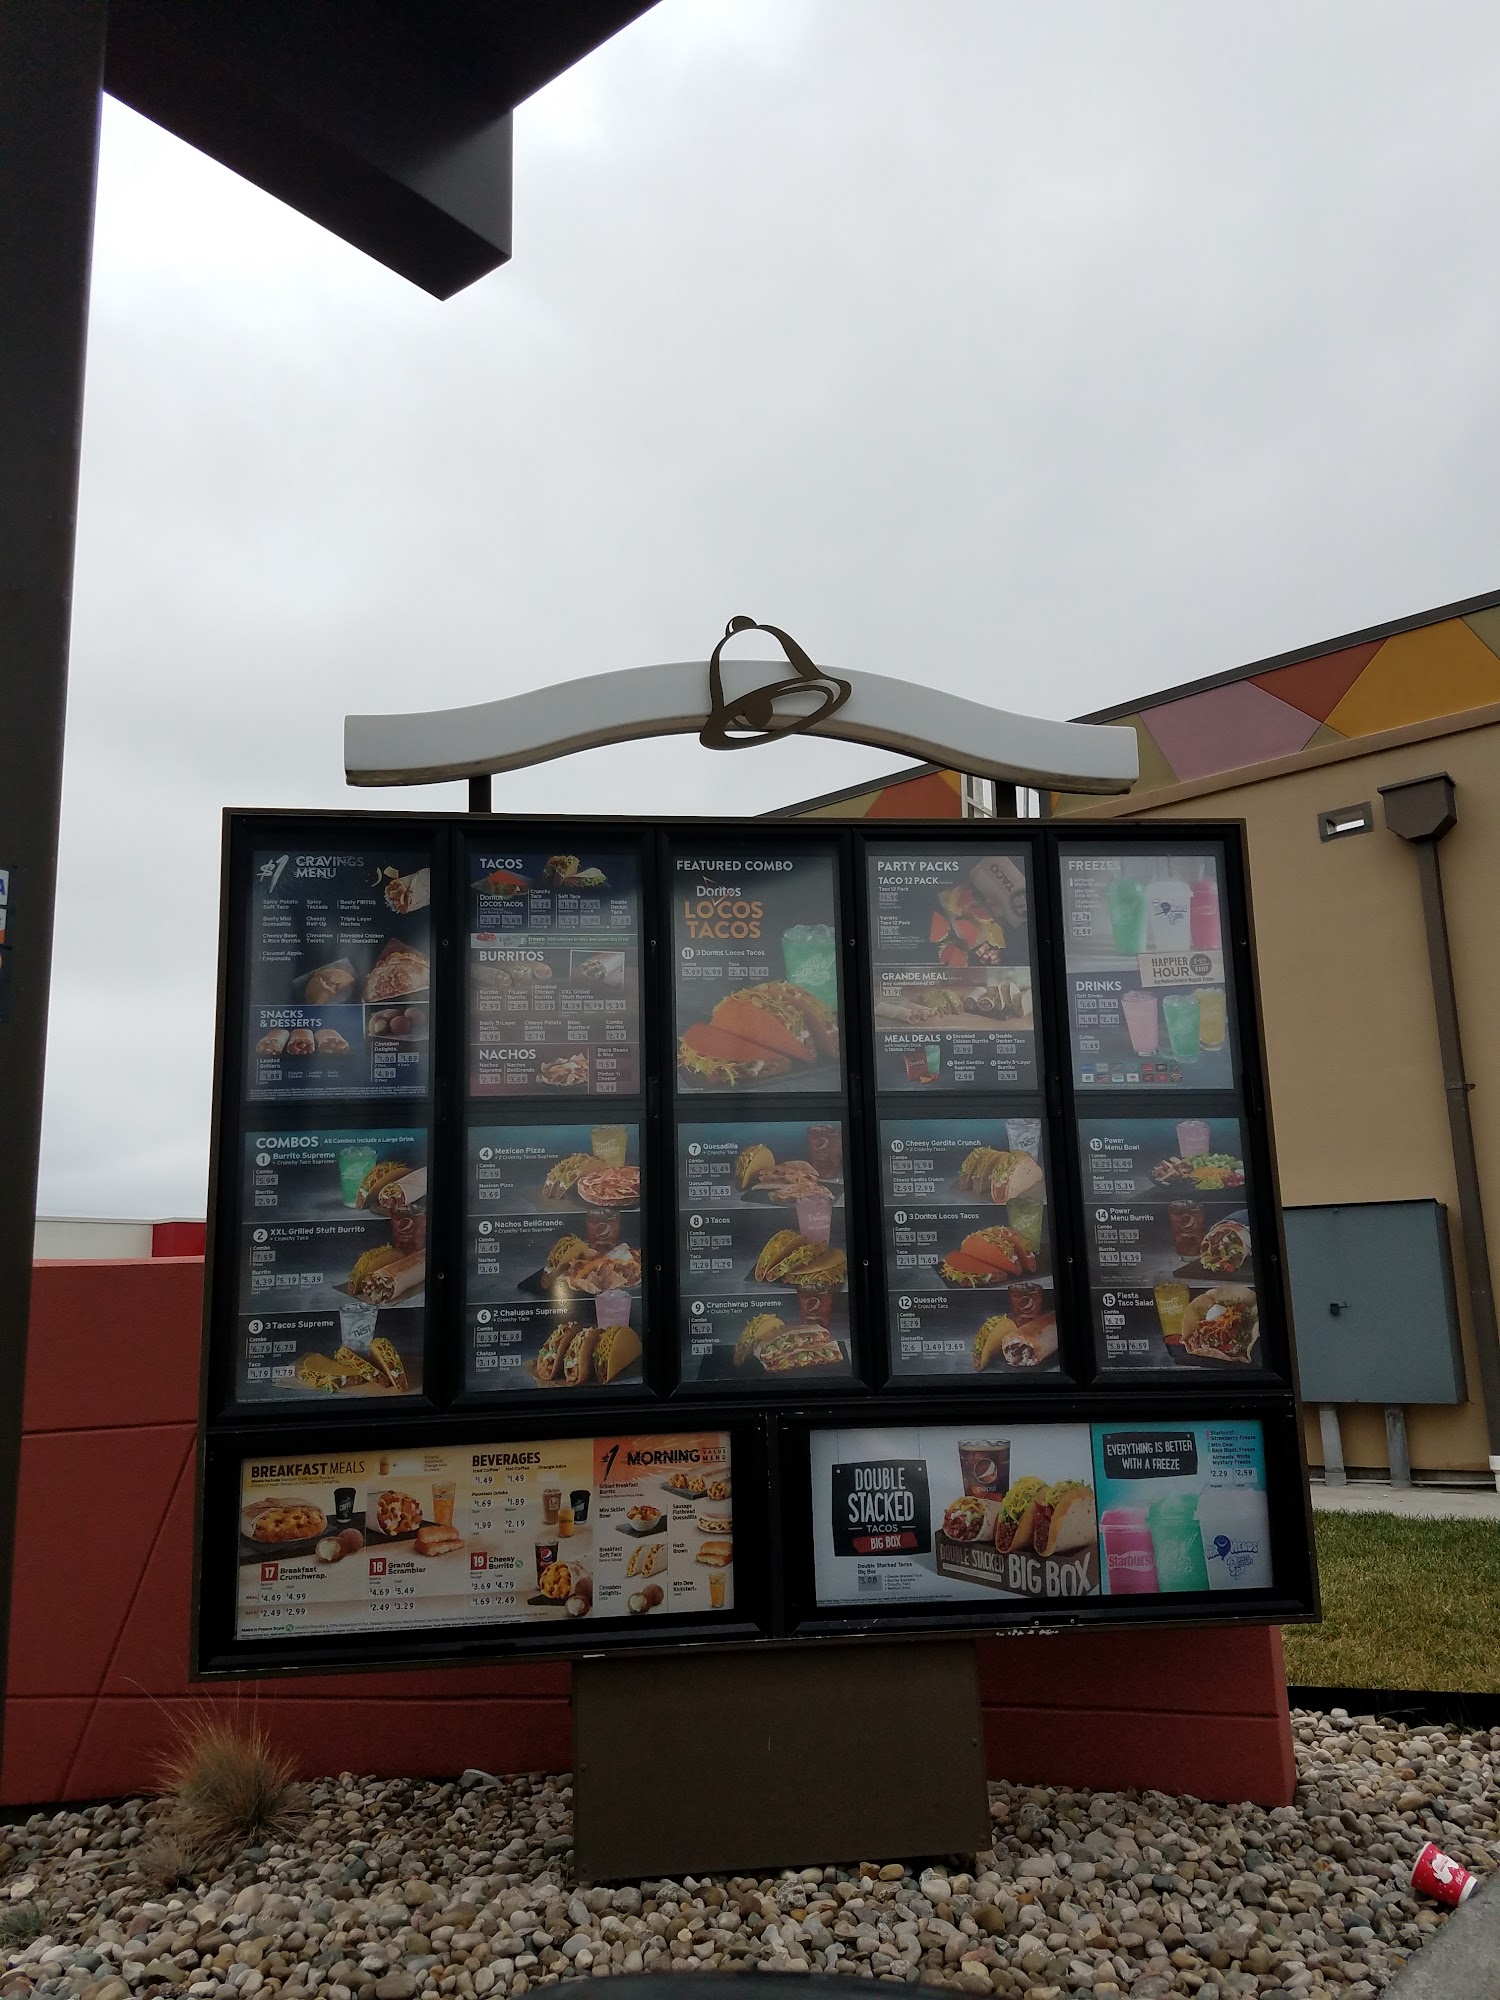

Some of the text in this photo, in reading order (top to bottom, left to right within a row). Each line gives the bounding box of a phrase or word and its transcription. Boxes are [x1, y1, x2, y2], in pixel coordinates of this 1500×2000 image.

[296, 856, 364, 867] CRAVINGS
[480, 858, 523, 869] TACOS
[677, 860, 793, 871] FEATURED COMBO
[878, 862, 959, 871] PARTY PACKS
[1069, 861, 1121, 870] FREEZES
[295, 868, 337, 878] MENU
[878, 877, 939, 885] TACO 12 PACK
[697, 886, 741, 897] Doritos
[685, 901, 763, 918] LOCOS
[687, 921, 761, 939] TACOS
[480, 951, 544, 961] BURRITOS
[1152, 957, 1189, 967] HAPPIER
[1153, 967, 1190, 977] HOUR
[1076, 981, 1122, 991] DRINKS
[260, 1010, 303, 1019] SNACKS
[260, 1019, 322, 1027] & DESSERTS
[885, 1035, 910, 1043] MEAL
[480, 1049, 536, 1060] NACHOS
[256, 1136, 319, 1148] COMBOS
[906, 1139, 930, 1147] Cheesy
[302, 1152, 335, 1160] Supreme
[288, 1227, 314, 1235] Grilled
[316, 1226, 335, 1234] Stuft
[707, 1301, 748, 1309] Crunchwrap
[500, 1309, 534, 1317] Chalupas
[536, 1308, 568, 1316] Supreme
[298, 1320, 334, 1330] Supreme
[1107, 1440, 1193, 1456] EVERYTHING IS BETTER
[472, 1452, 540, 1467] BEVERAGES
[627, 1450, 700, 1465] MORNING
[1122, 1458, 1180, 1470] WITH A FREEZE
[251, 1461, 365, 1478] BREAKFAST MEALS
[855, 1468, 906, 1490] DOUBLE
[848, 1492, 914, 1523] STACKED
[866, 1524, 898, 1533] TACOS
[871, 1535, 901, 1549] BIG BOX
[489, 1556, 515, 1564] Cheesy
[940, 1544, 1091, 1597] DOUBLE STACKED BIG BOX
